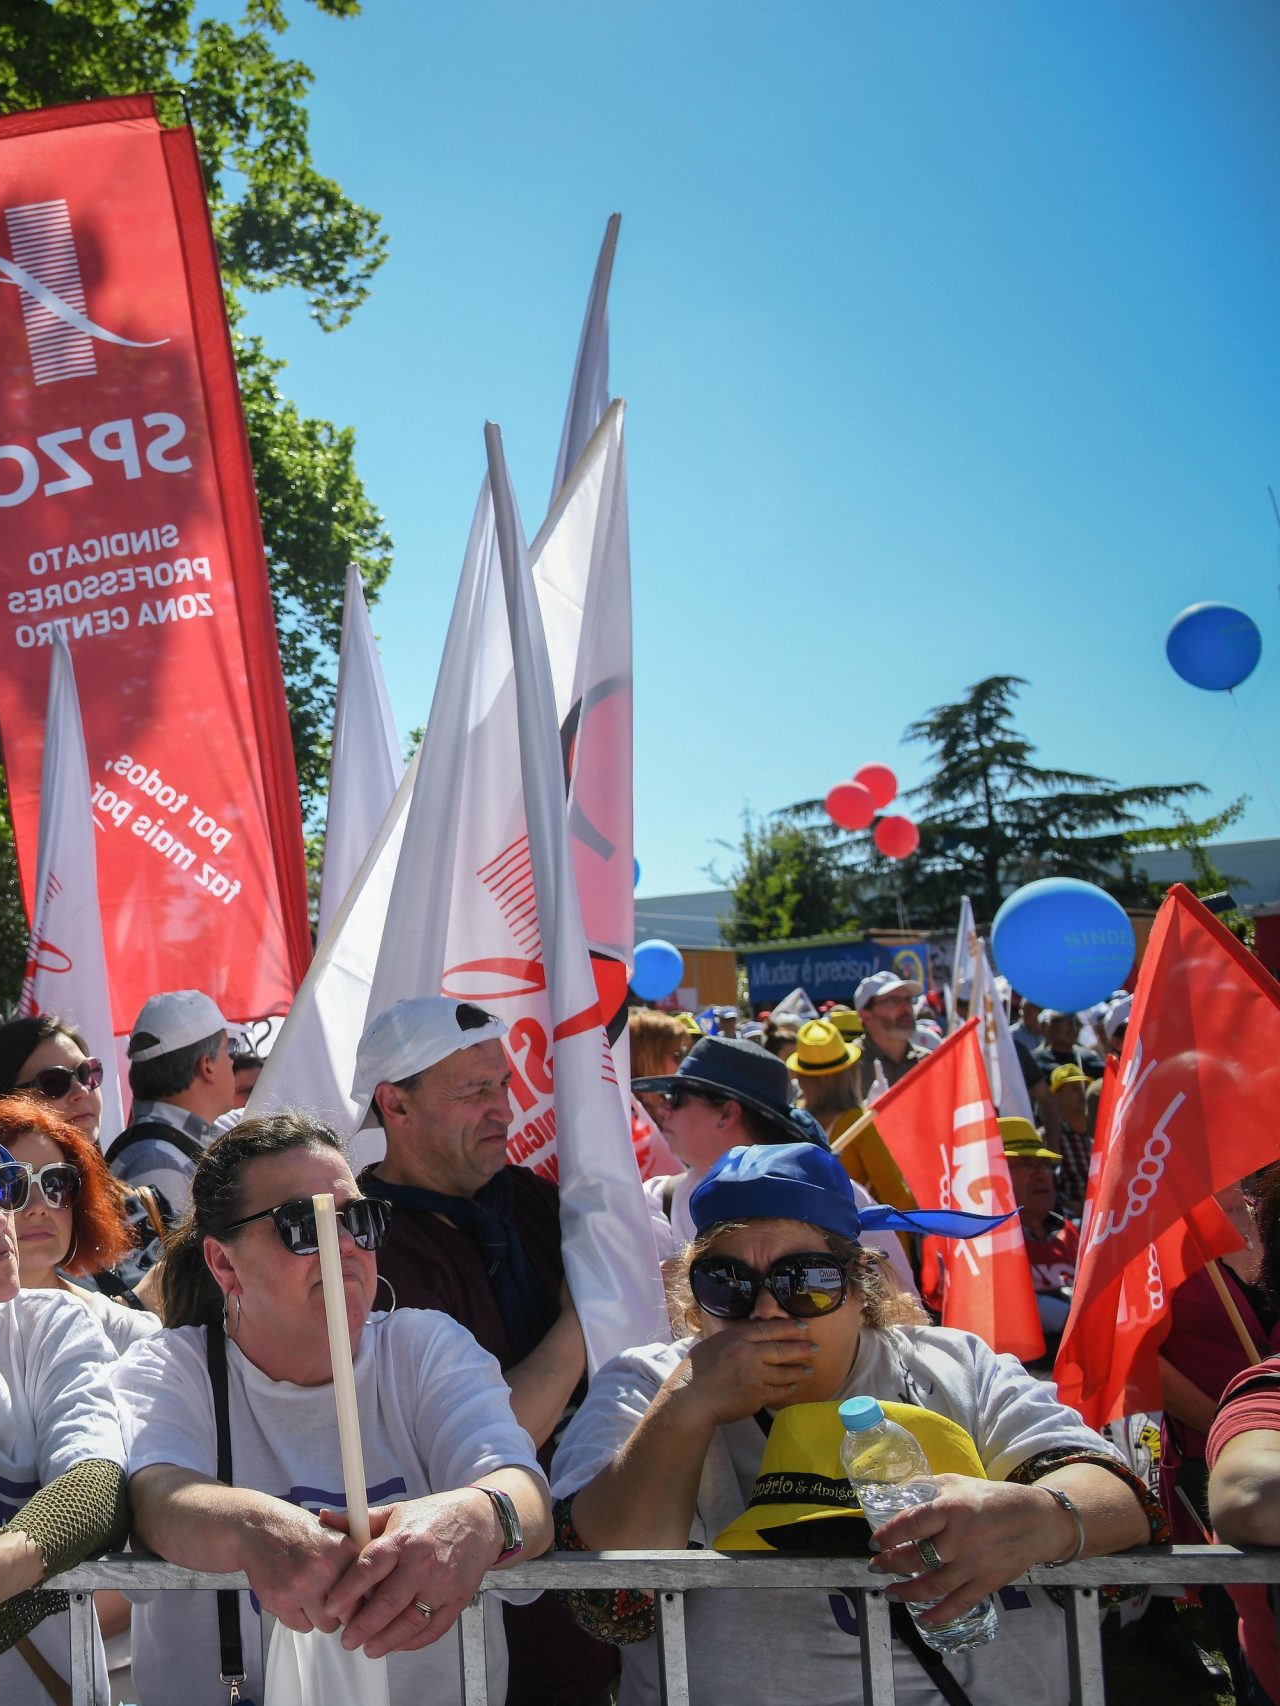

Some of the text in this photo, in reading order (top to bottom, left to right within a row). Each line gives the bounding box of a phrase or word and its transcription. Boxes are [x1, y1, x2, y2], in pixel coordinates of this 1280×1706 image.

[752, 956, 881, 988] Mudar é preciso!
[795, 1479, 808, 1495] &
[810, 1482, 856, 1501] Amigo
